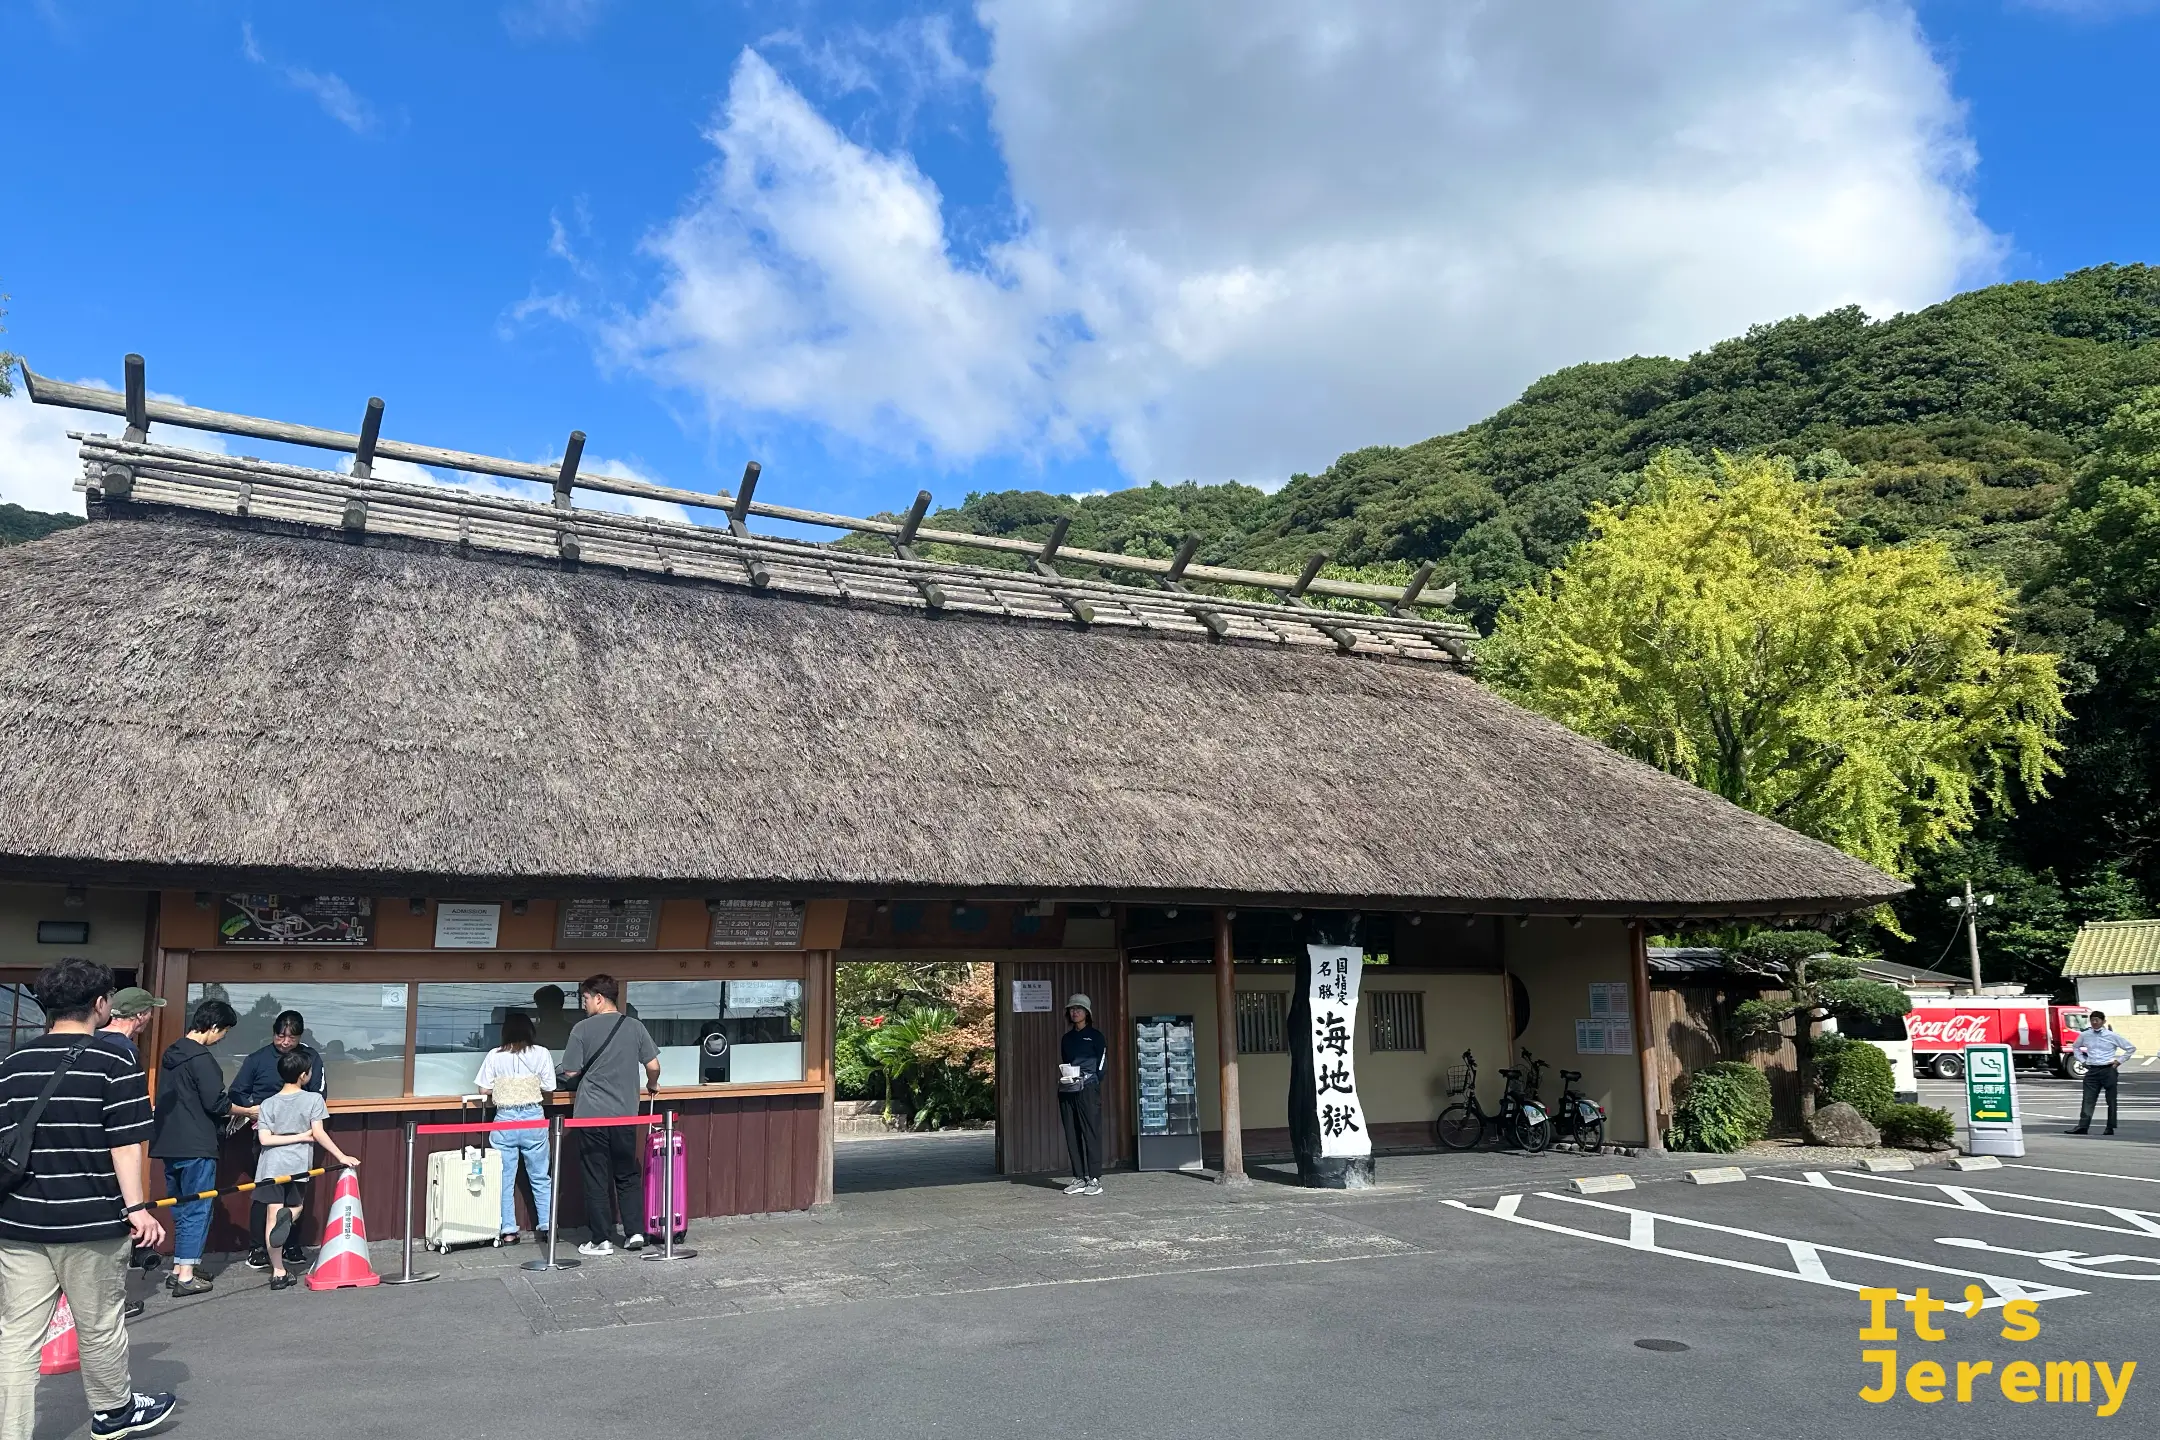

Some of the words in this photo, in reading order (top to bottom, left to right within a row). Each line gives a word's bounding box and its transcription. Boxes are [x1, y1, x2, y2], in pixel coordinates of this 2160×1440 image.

[1317, 961, 1334, 1000] 名勝
[1335, 957, 1349, 1006] 国指定
[1315, 1011, 1360, 1137] 海地獄
[1972, 1084, 2006, 1095] 喫煙所
